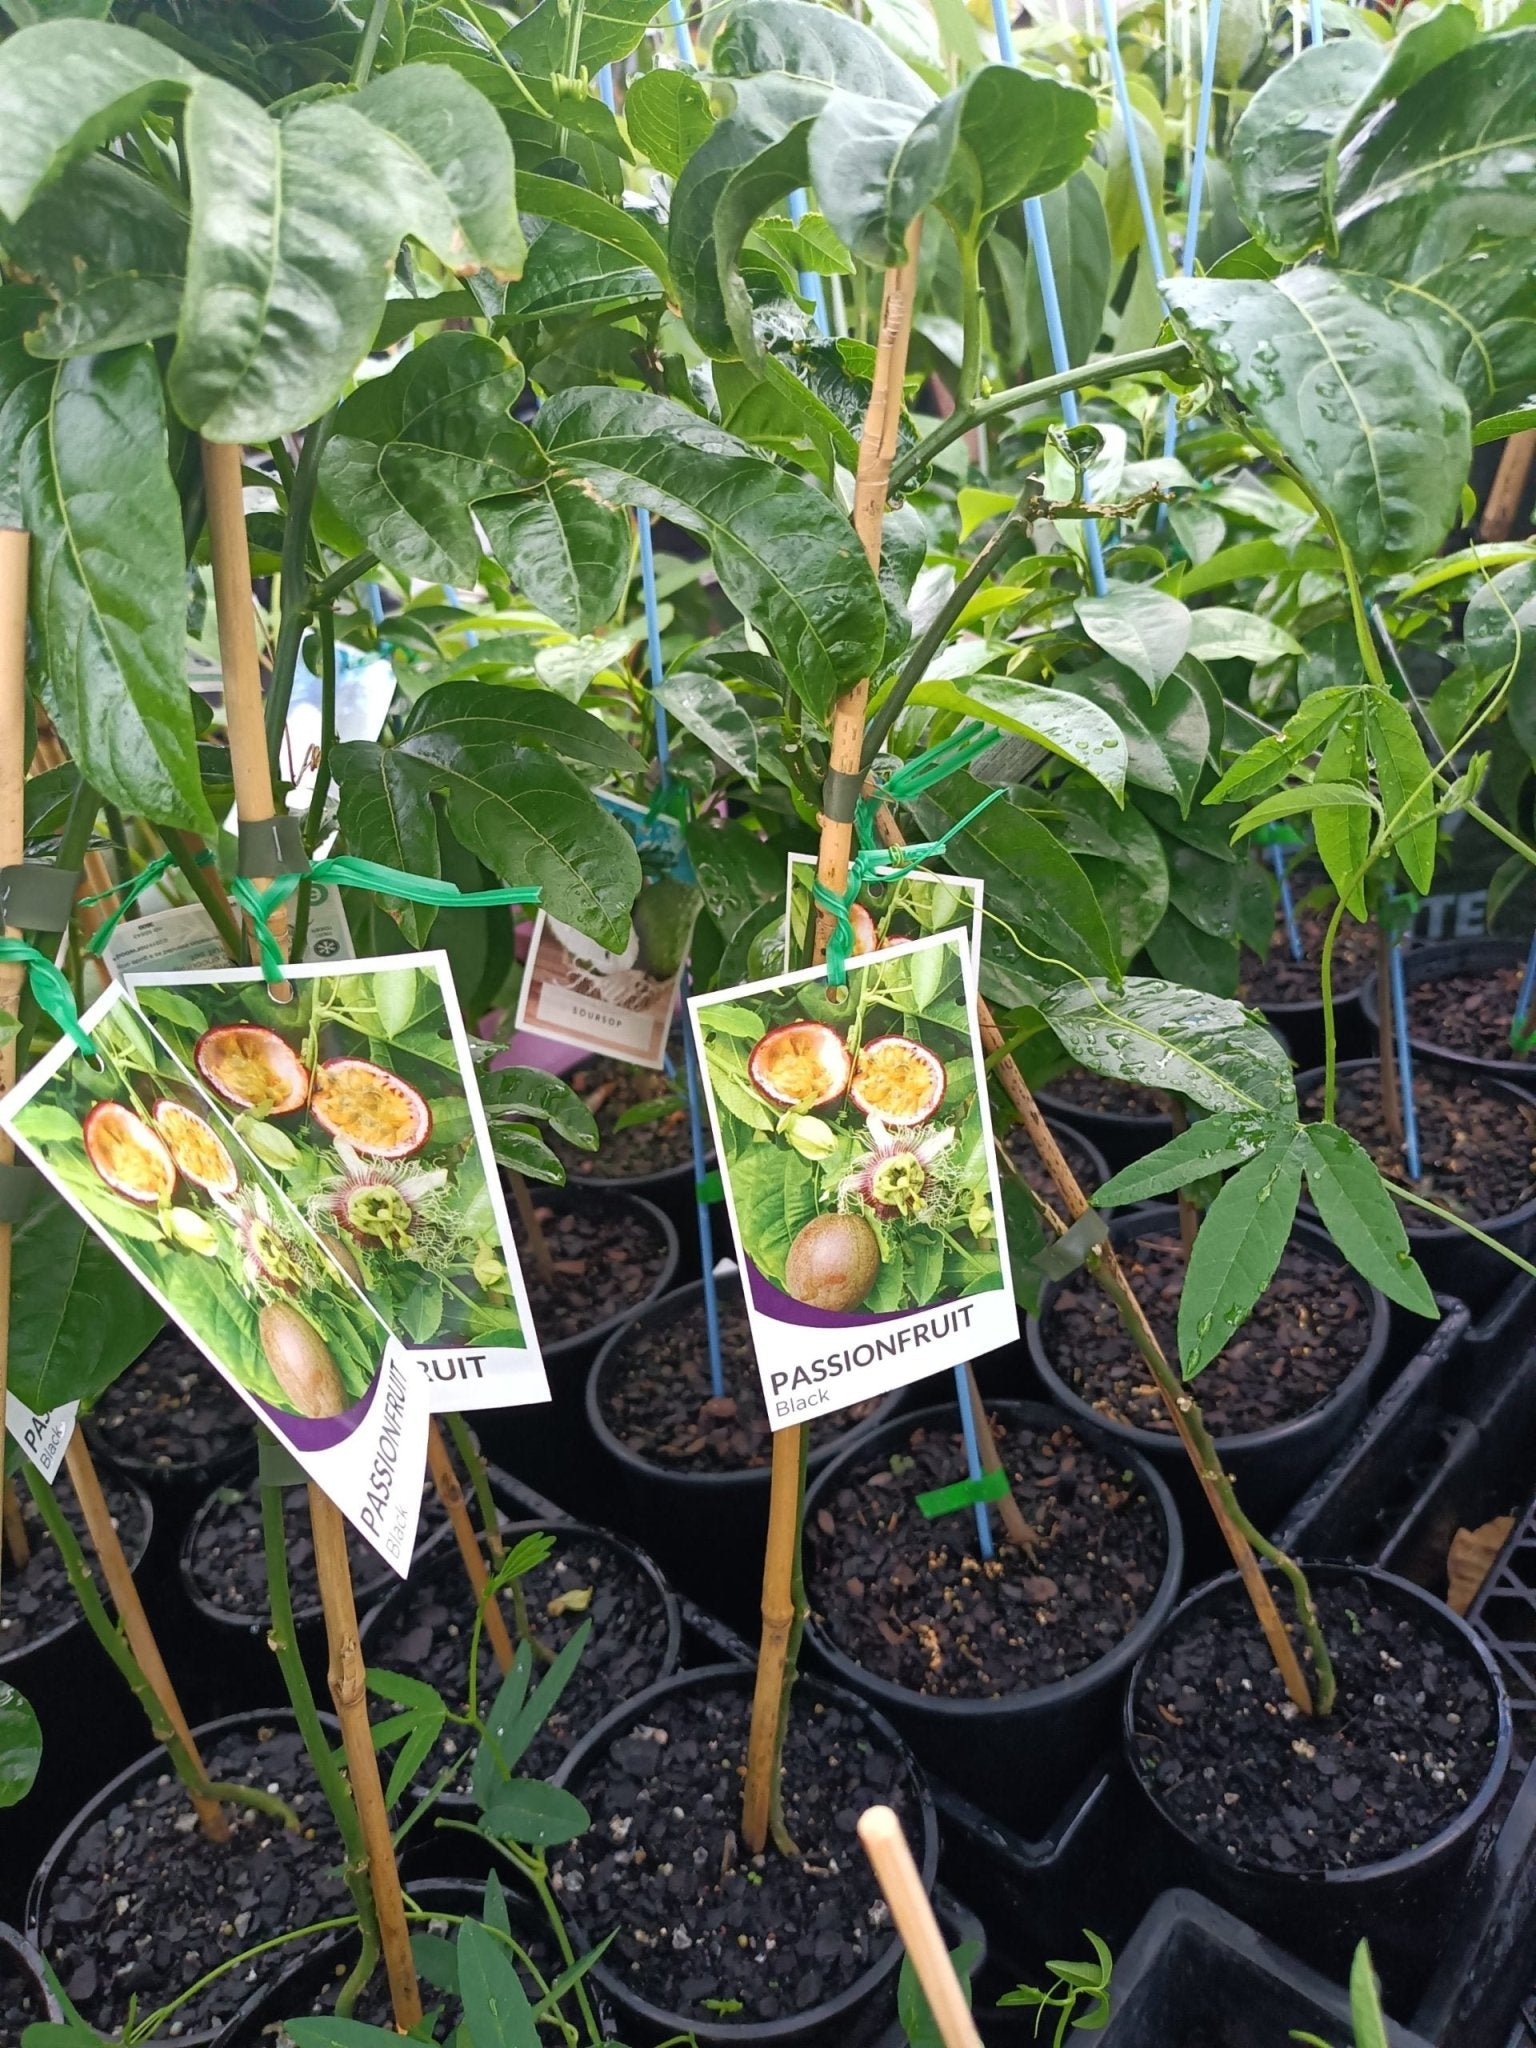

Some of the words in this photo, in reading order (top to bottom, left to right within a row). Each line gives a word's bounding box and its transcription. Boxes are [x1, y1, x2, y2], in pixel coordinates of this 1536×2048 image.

[572, 1005, 623, 1028] SOURSOP
[770, 1303, 975, 1396] PASSIONFRUIT
[776, 1386, 831, 1418] Black
[40, 1425, 63, 1469] Black
[360, 1358, 407, 1538] PASSIONFRUIT
[386, 1503, 409, 1560] Black
